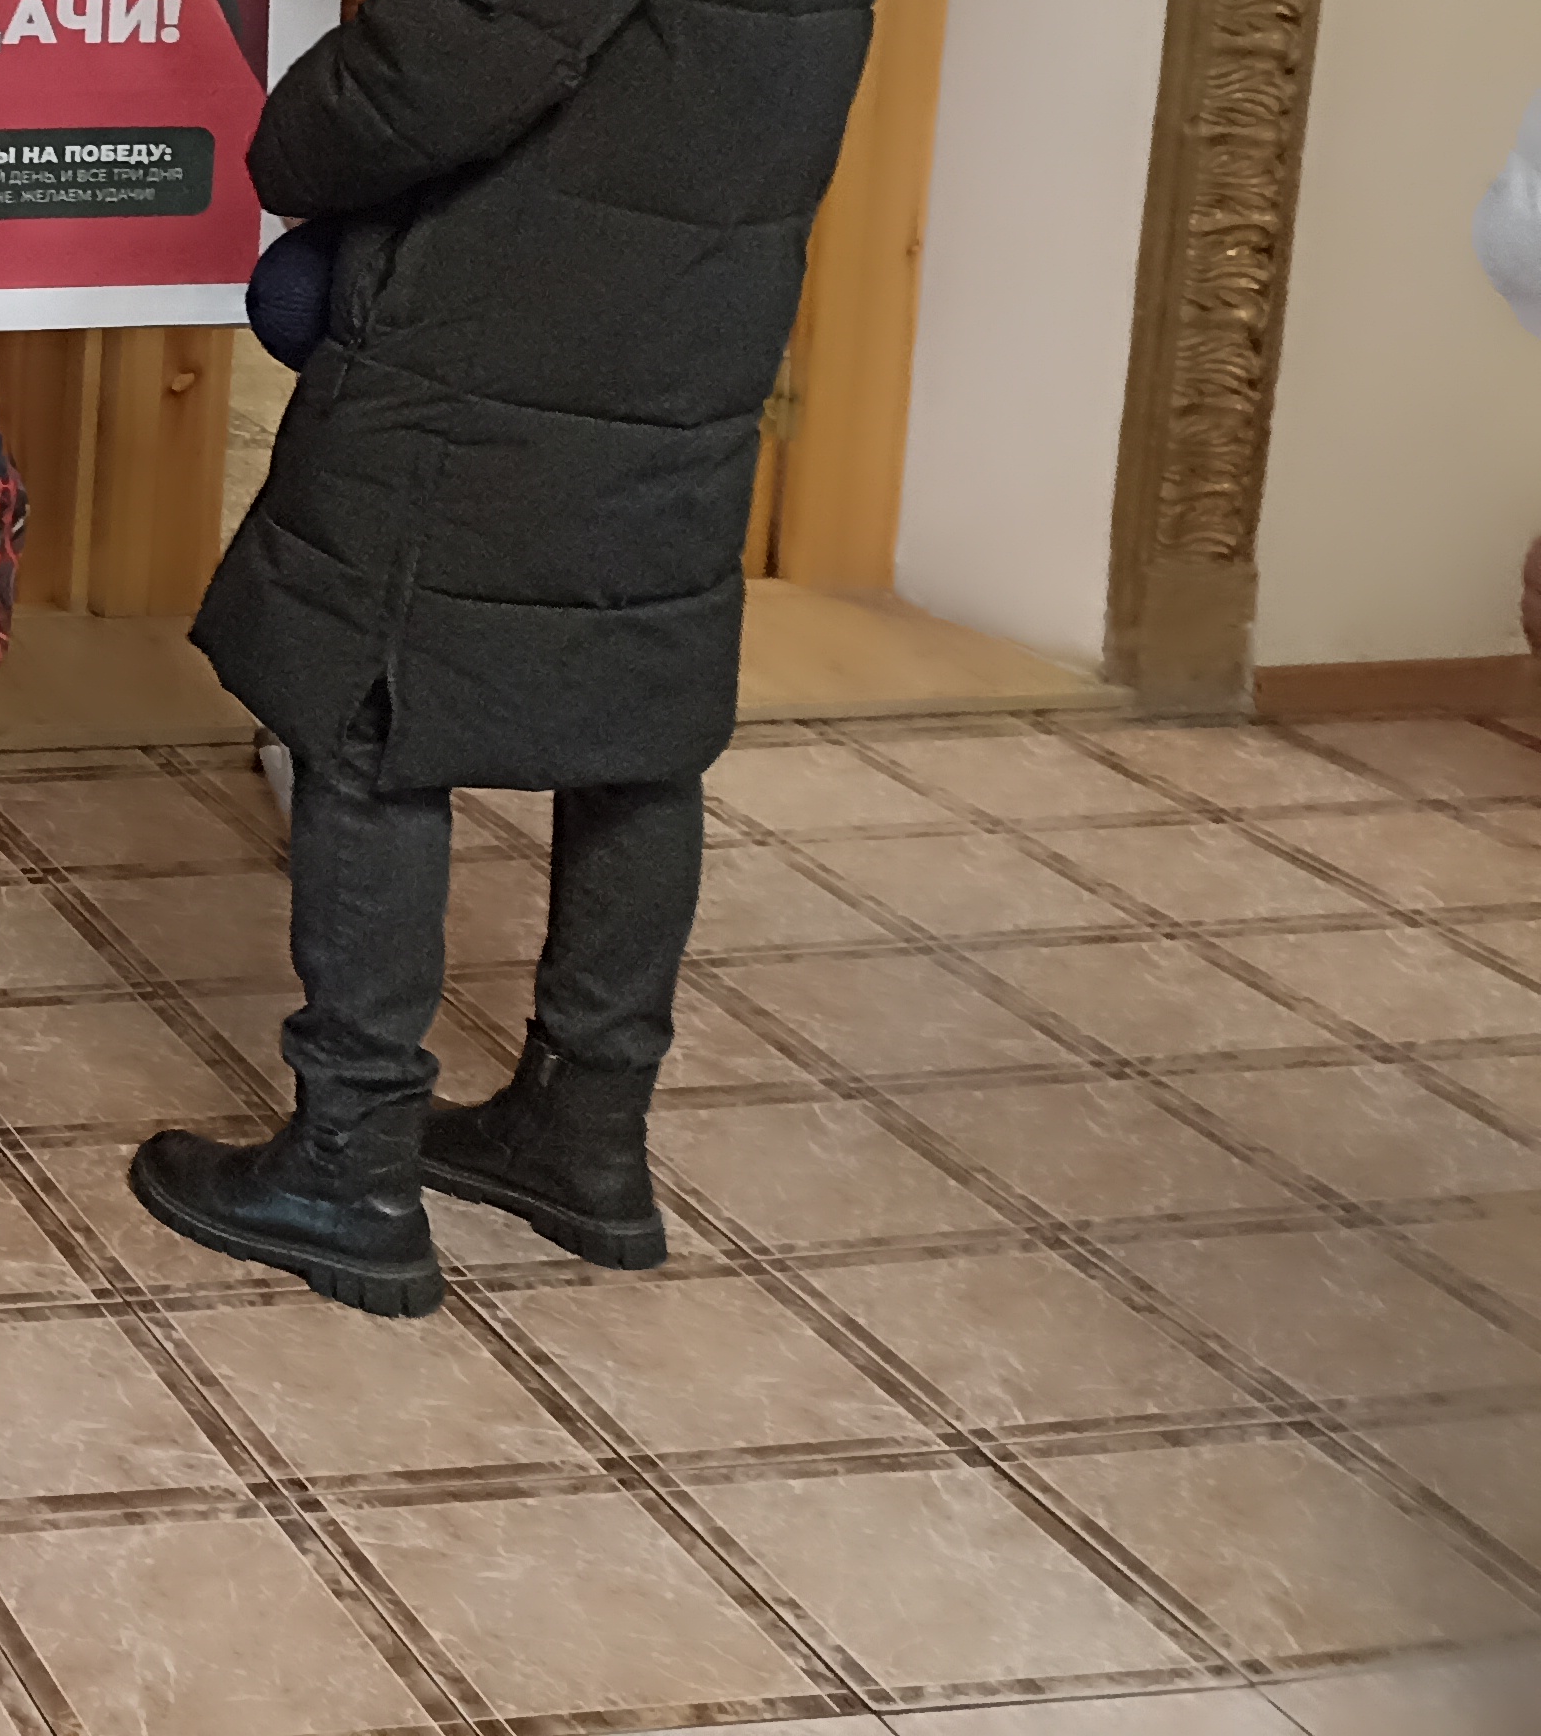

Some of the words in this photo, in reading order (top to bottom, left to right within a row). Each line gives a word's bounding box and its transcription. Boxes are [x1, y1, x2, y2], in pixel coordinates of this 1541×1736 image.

[22, 146, 58, 164] НА
[64, 143, 173, 165] ПОБЕДУ:
[60, 170, 73, 183] И
